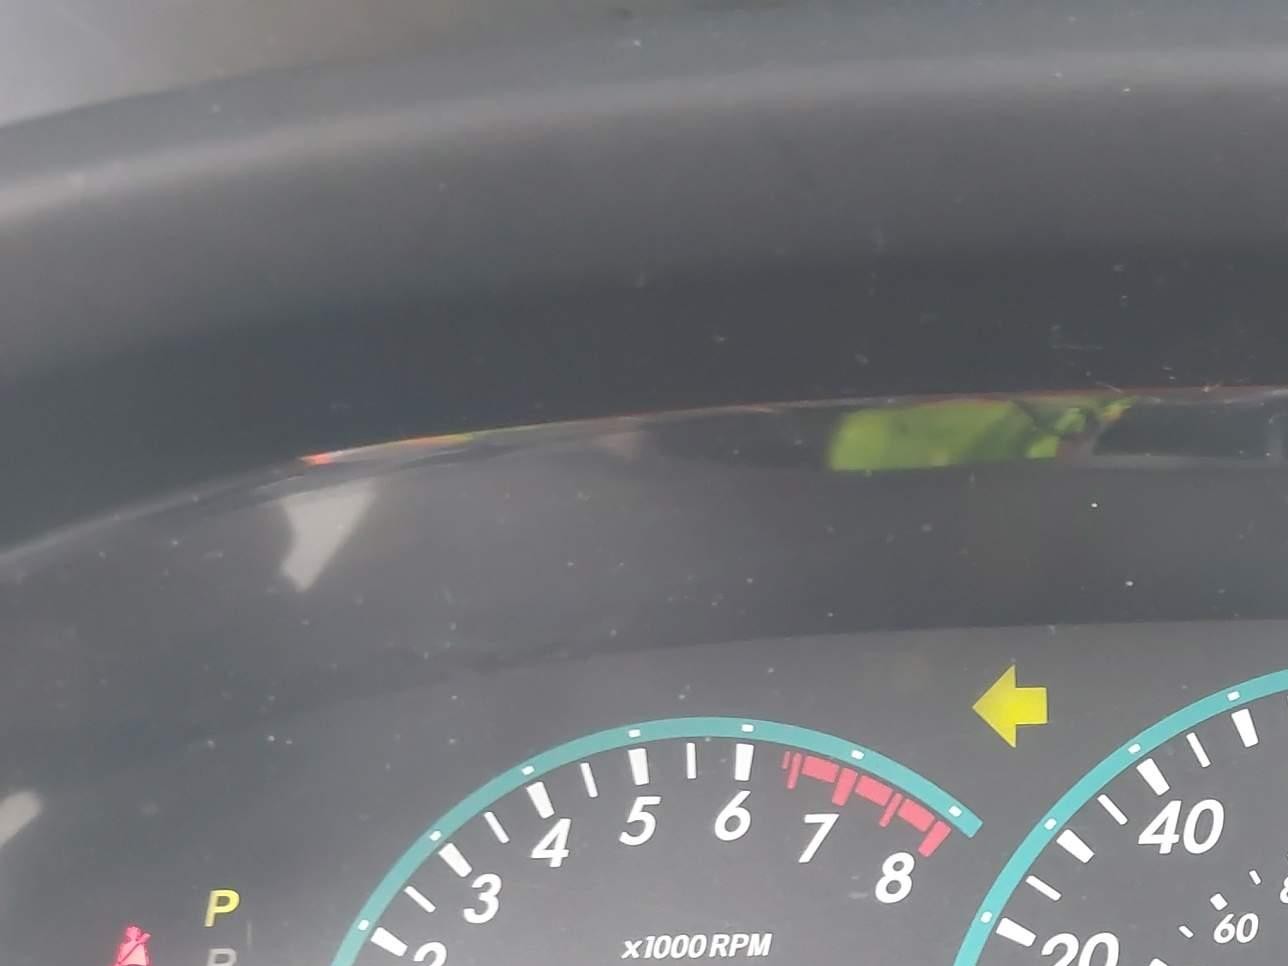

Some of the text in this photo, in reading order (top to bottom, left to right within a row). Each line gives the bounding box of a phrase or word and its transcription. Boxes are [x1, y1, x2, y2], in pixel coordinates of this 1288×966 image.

[618, 796, 661, 845] 5
[713, 790, 751, 841] 6
[798, 813, 839, 863] 7
[1138, 799, 1225, 854] 40
[531, 818, 571, 868] 4
[463, 873, 502, 924] 3
[874, 852, 916, 903] 8
[205, 889, 240, 927] P
[1213, 913, 1259, 943] 60
[709, 933, 772, 958] RPM
